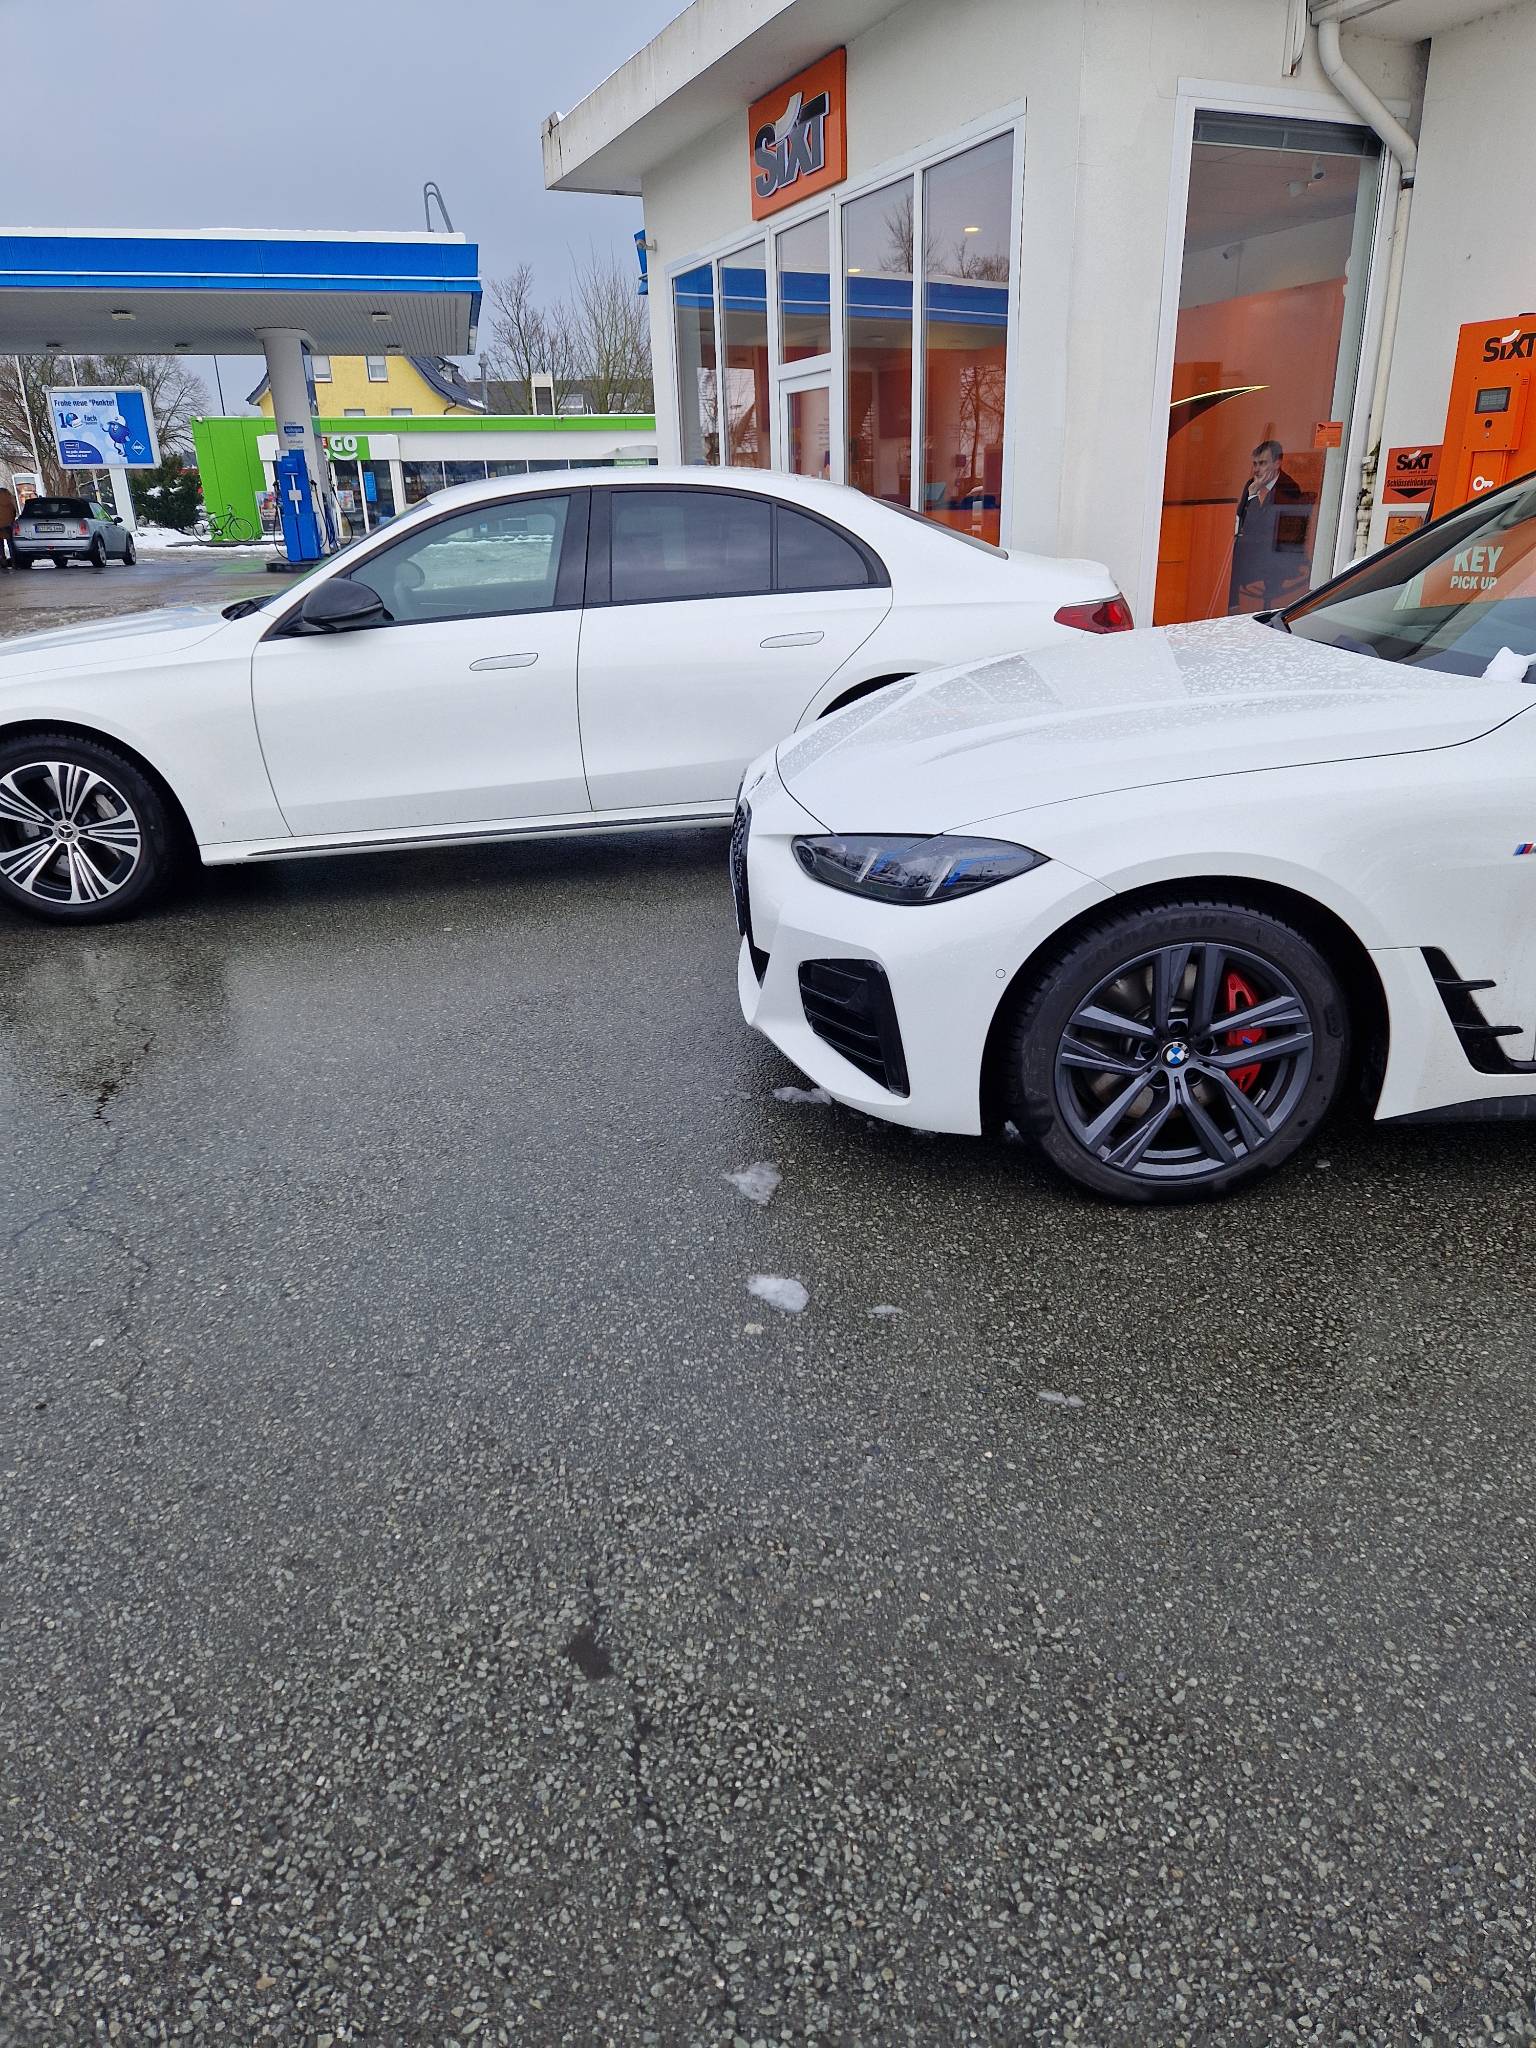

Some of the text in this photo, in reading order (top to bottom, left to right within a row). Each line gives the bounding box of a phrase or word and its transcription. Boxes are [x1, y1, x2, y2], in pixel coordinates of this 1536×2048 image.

[330, 435, 358, 452] GO
[1453, 546, 1504, 573] KEY
[1450, 575, 1498, 590] PICK UP
